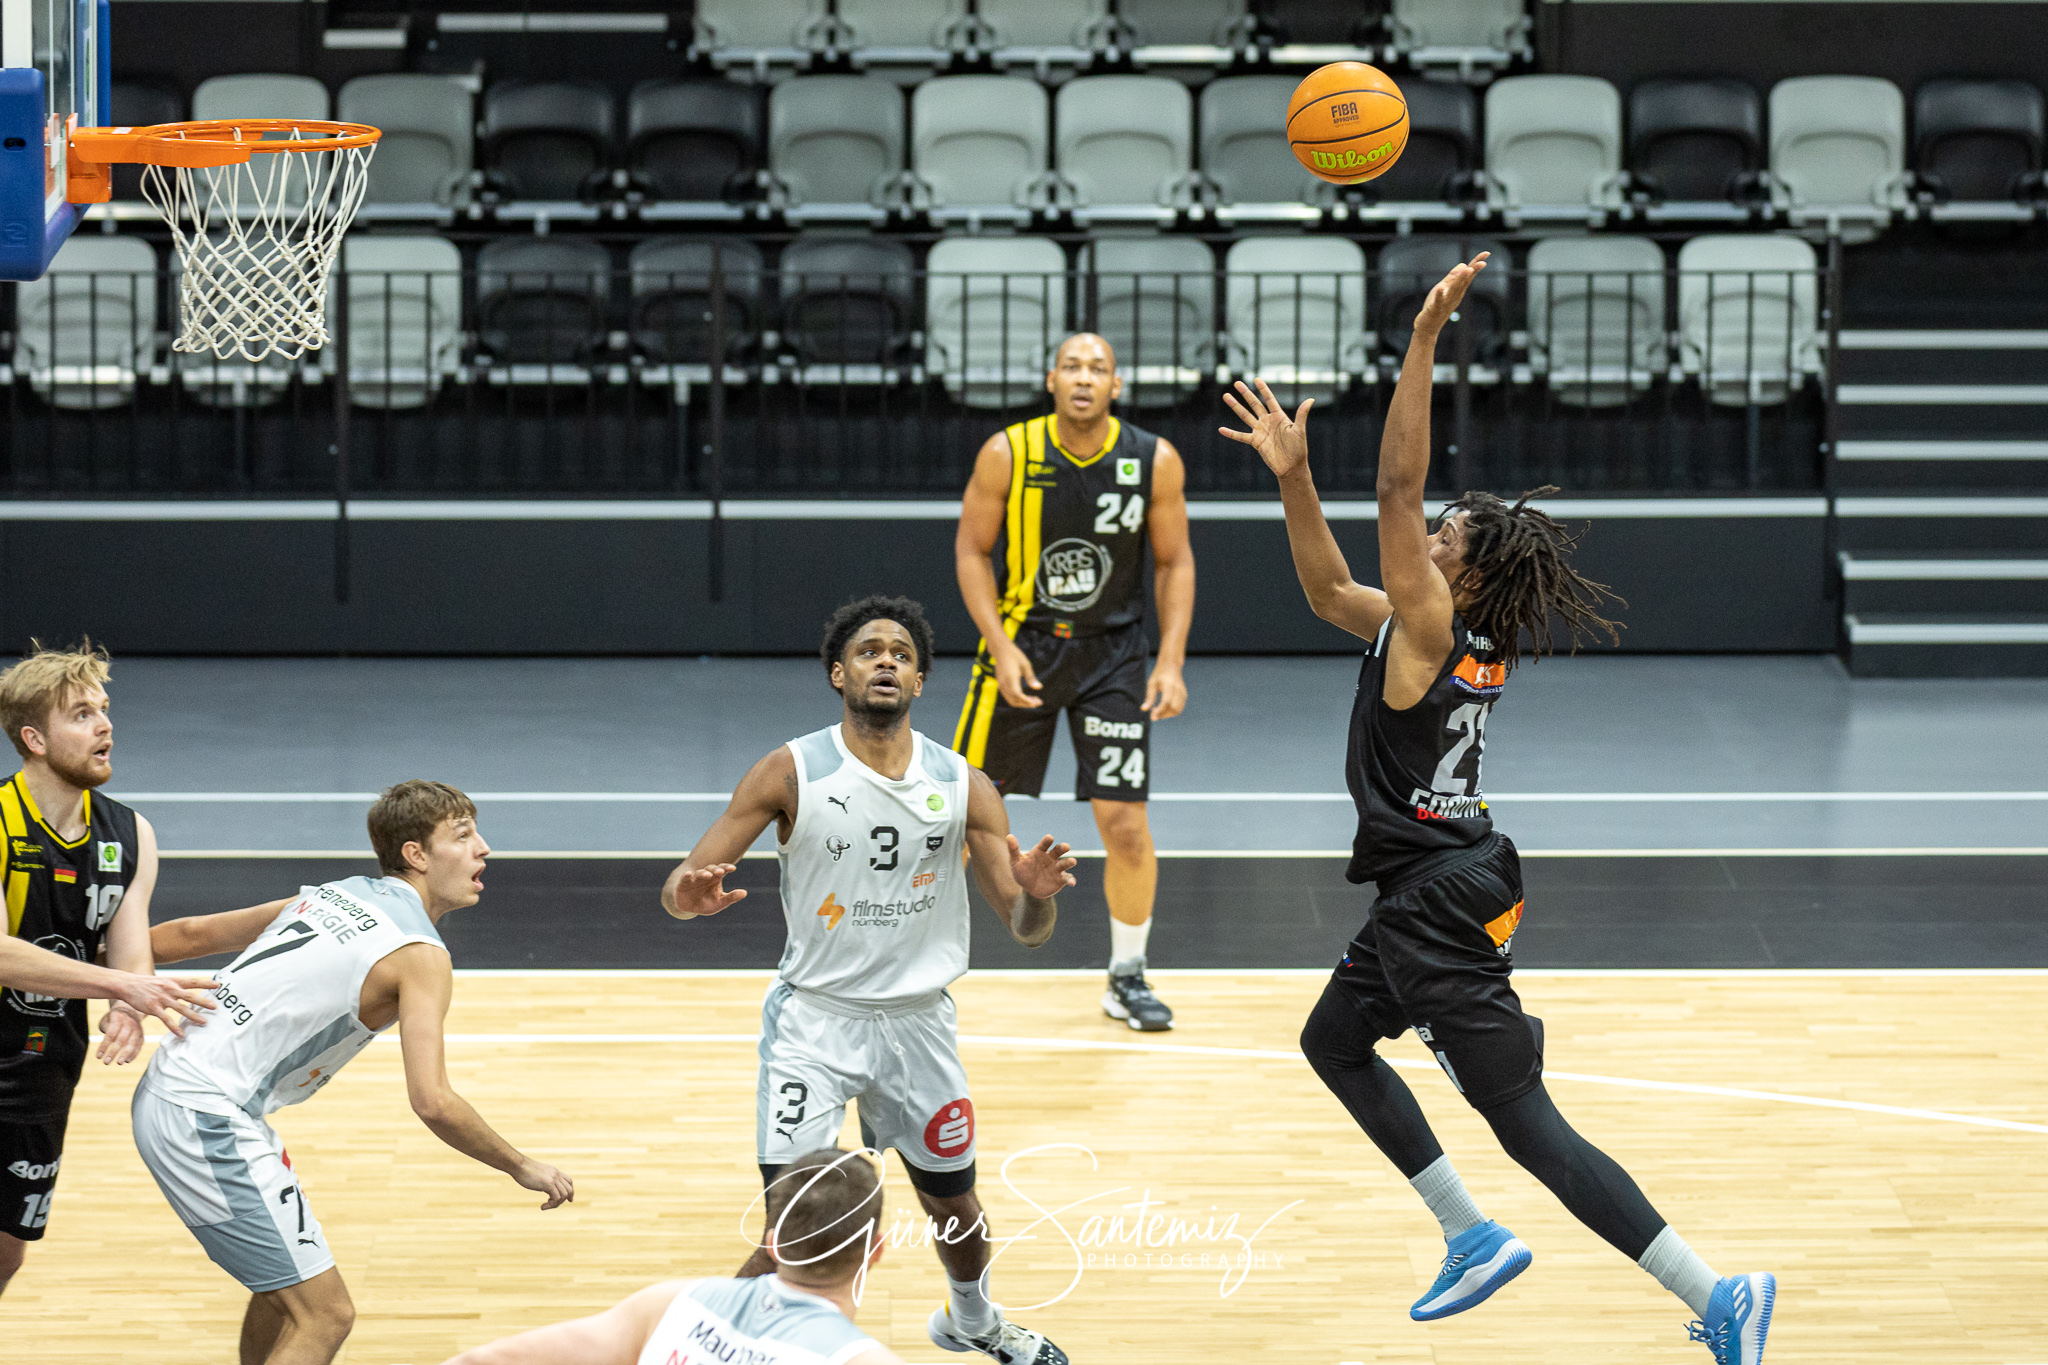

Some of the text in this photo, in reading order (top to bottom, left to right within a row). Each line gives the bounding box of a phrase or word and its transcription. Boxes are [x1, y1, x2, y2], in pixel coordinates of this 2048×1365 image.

[1331, 102, 1358, 118] FIBA
[1311, 141, 1393, 169] Wilson
[1094, 493, 1145, 534] 24
[1084, 716, 1143, 739] Bona
[1096, 746, 1145, 789] 24
[869, 826, 900, 871] 3
[852, 895, 936, 917] filmstudio
[230, 919, 319, 973] 7
[776, 1081, 808, 1125] 3
[7, 1154, 62, 1180] Bon
[279, 1185, 305, 1233] 7
